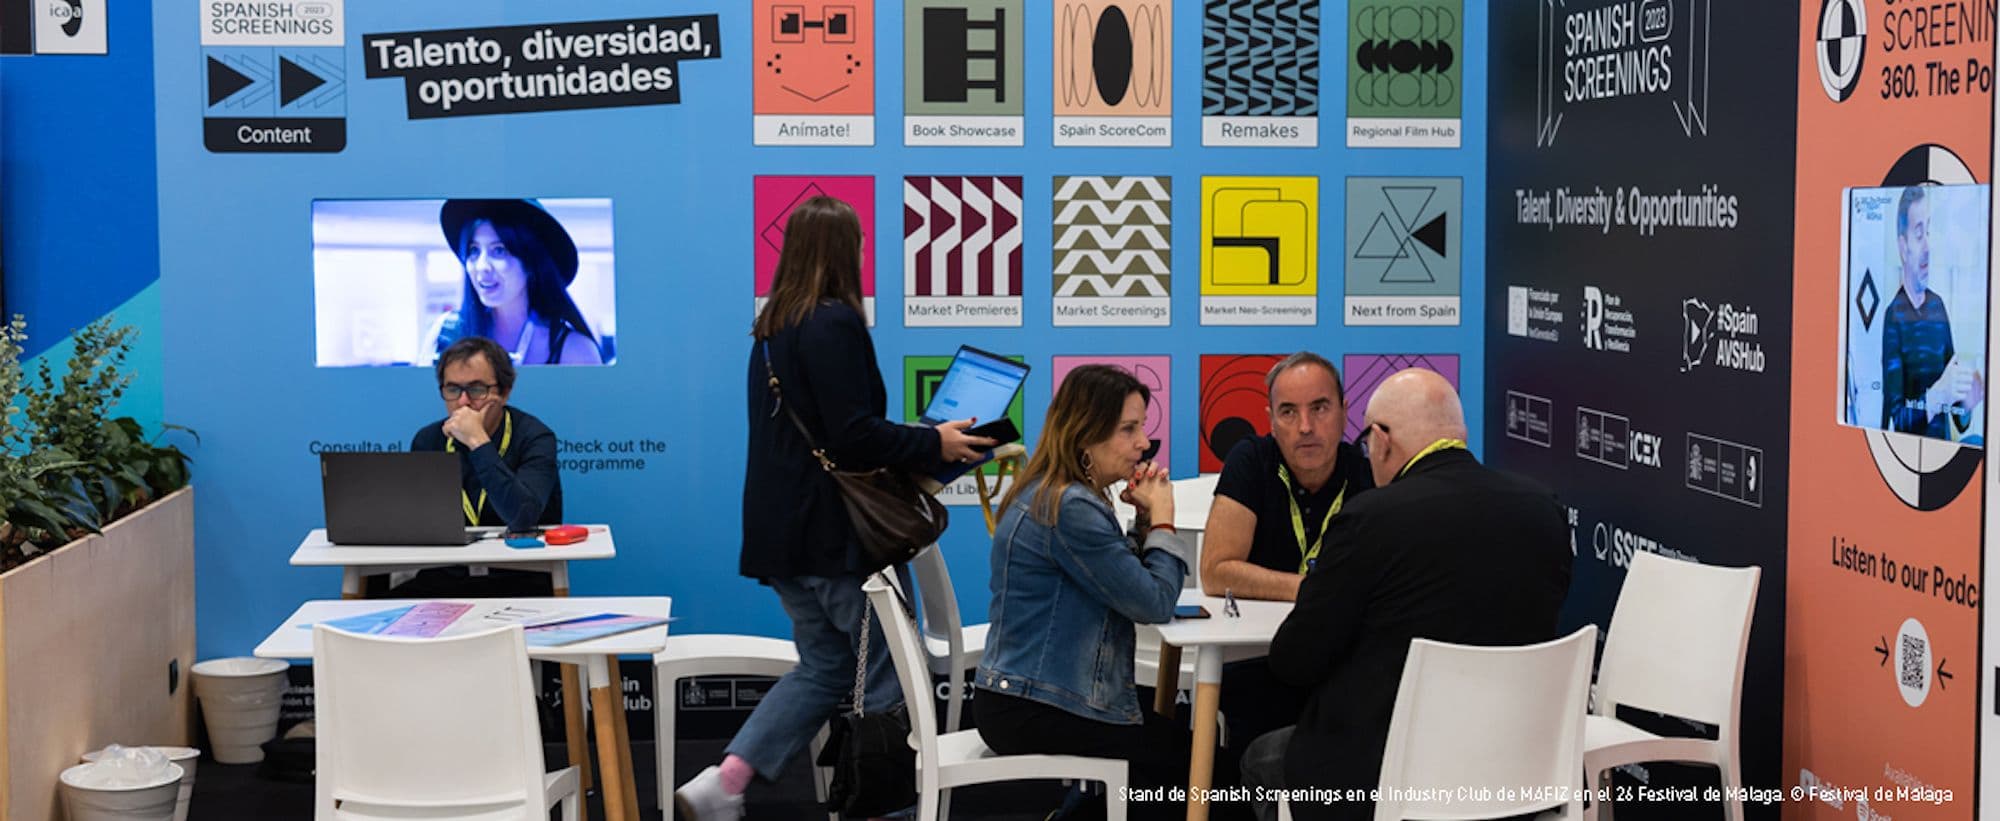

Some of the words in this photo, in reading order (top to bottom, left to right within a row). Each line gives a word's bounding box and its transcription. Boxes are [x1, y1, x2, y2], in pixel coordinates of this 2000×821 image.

[211, 2, 293, 18] SPANISH
[304, 7, 325, 15] 2023
[211, 19, 333, 35] SCREENINGS
[1565, 1, 1635, 57] SPANISH
[1644, 6, 1667, 31] 2023
[371, 36, 512, 70] Talento,
[522, 21, 711, 62] diversidad,
[1564, 44, 1672, 103] SCREENINGS
[1881, 64, 1919, 100] 360.
[1926, 61, 1960, 96] The
[419, 62, 673, 110] oportunidades
[237, 125, 312, 144] Content
[778, 122, 850, 138] Anímate!
[912, 124, 947, 137] Book
[949, 124, 1016, 137] Showcase
[1059, 124, 1096, 139] Spain
[1099, 124, 1167, 137] ScoreCom
[1221, 122, 1299, 138] Remakes
[1353, 126, 1402, 139] Regional
[1405, 126, 1429, 137] Film
[1431, 126, 1455, 137] Hub
[1515, 189, 1553, 232] Talent,
[1556, 185, 1613, 235] Diversity
[1615, 187, 1626, 225] &
[1628, 184, 1739, 236] Opportunities
[908, 304, 951, 316] Market
[955, 304, 1018, 316] Premieres
[1056, 305, 1098, 317] Market
[1102, 305, 1167, 319] Screenings
[1204, 306, 1237, 315] Market
[1239, 306, 1312, 317] Neo-Screenings
[1352, 305, 1383, 317] Next
[1386, 304, 1416, 317] from
[1419, 305, 1456, 320] Spain
[1717, 303, 1758, 338] #Spain
[1715, 339, 1766, 373] AVSHub
[309, 440, 383, 454] Consulta
[388, 440, 401, 452] el
[608, 440, 634, 453] out
[639, 440, 666, 453] the
[1832, 536, 1876, 577] Listen
[1881, 552, 1896, 584] to
[1901, 563, 1929, 593] our
